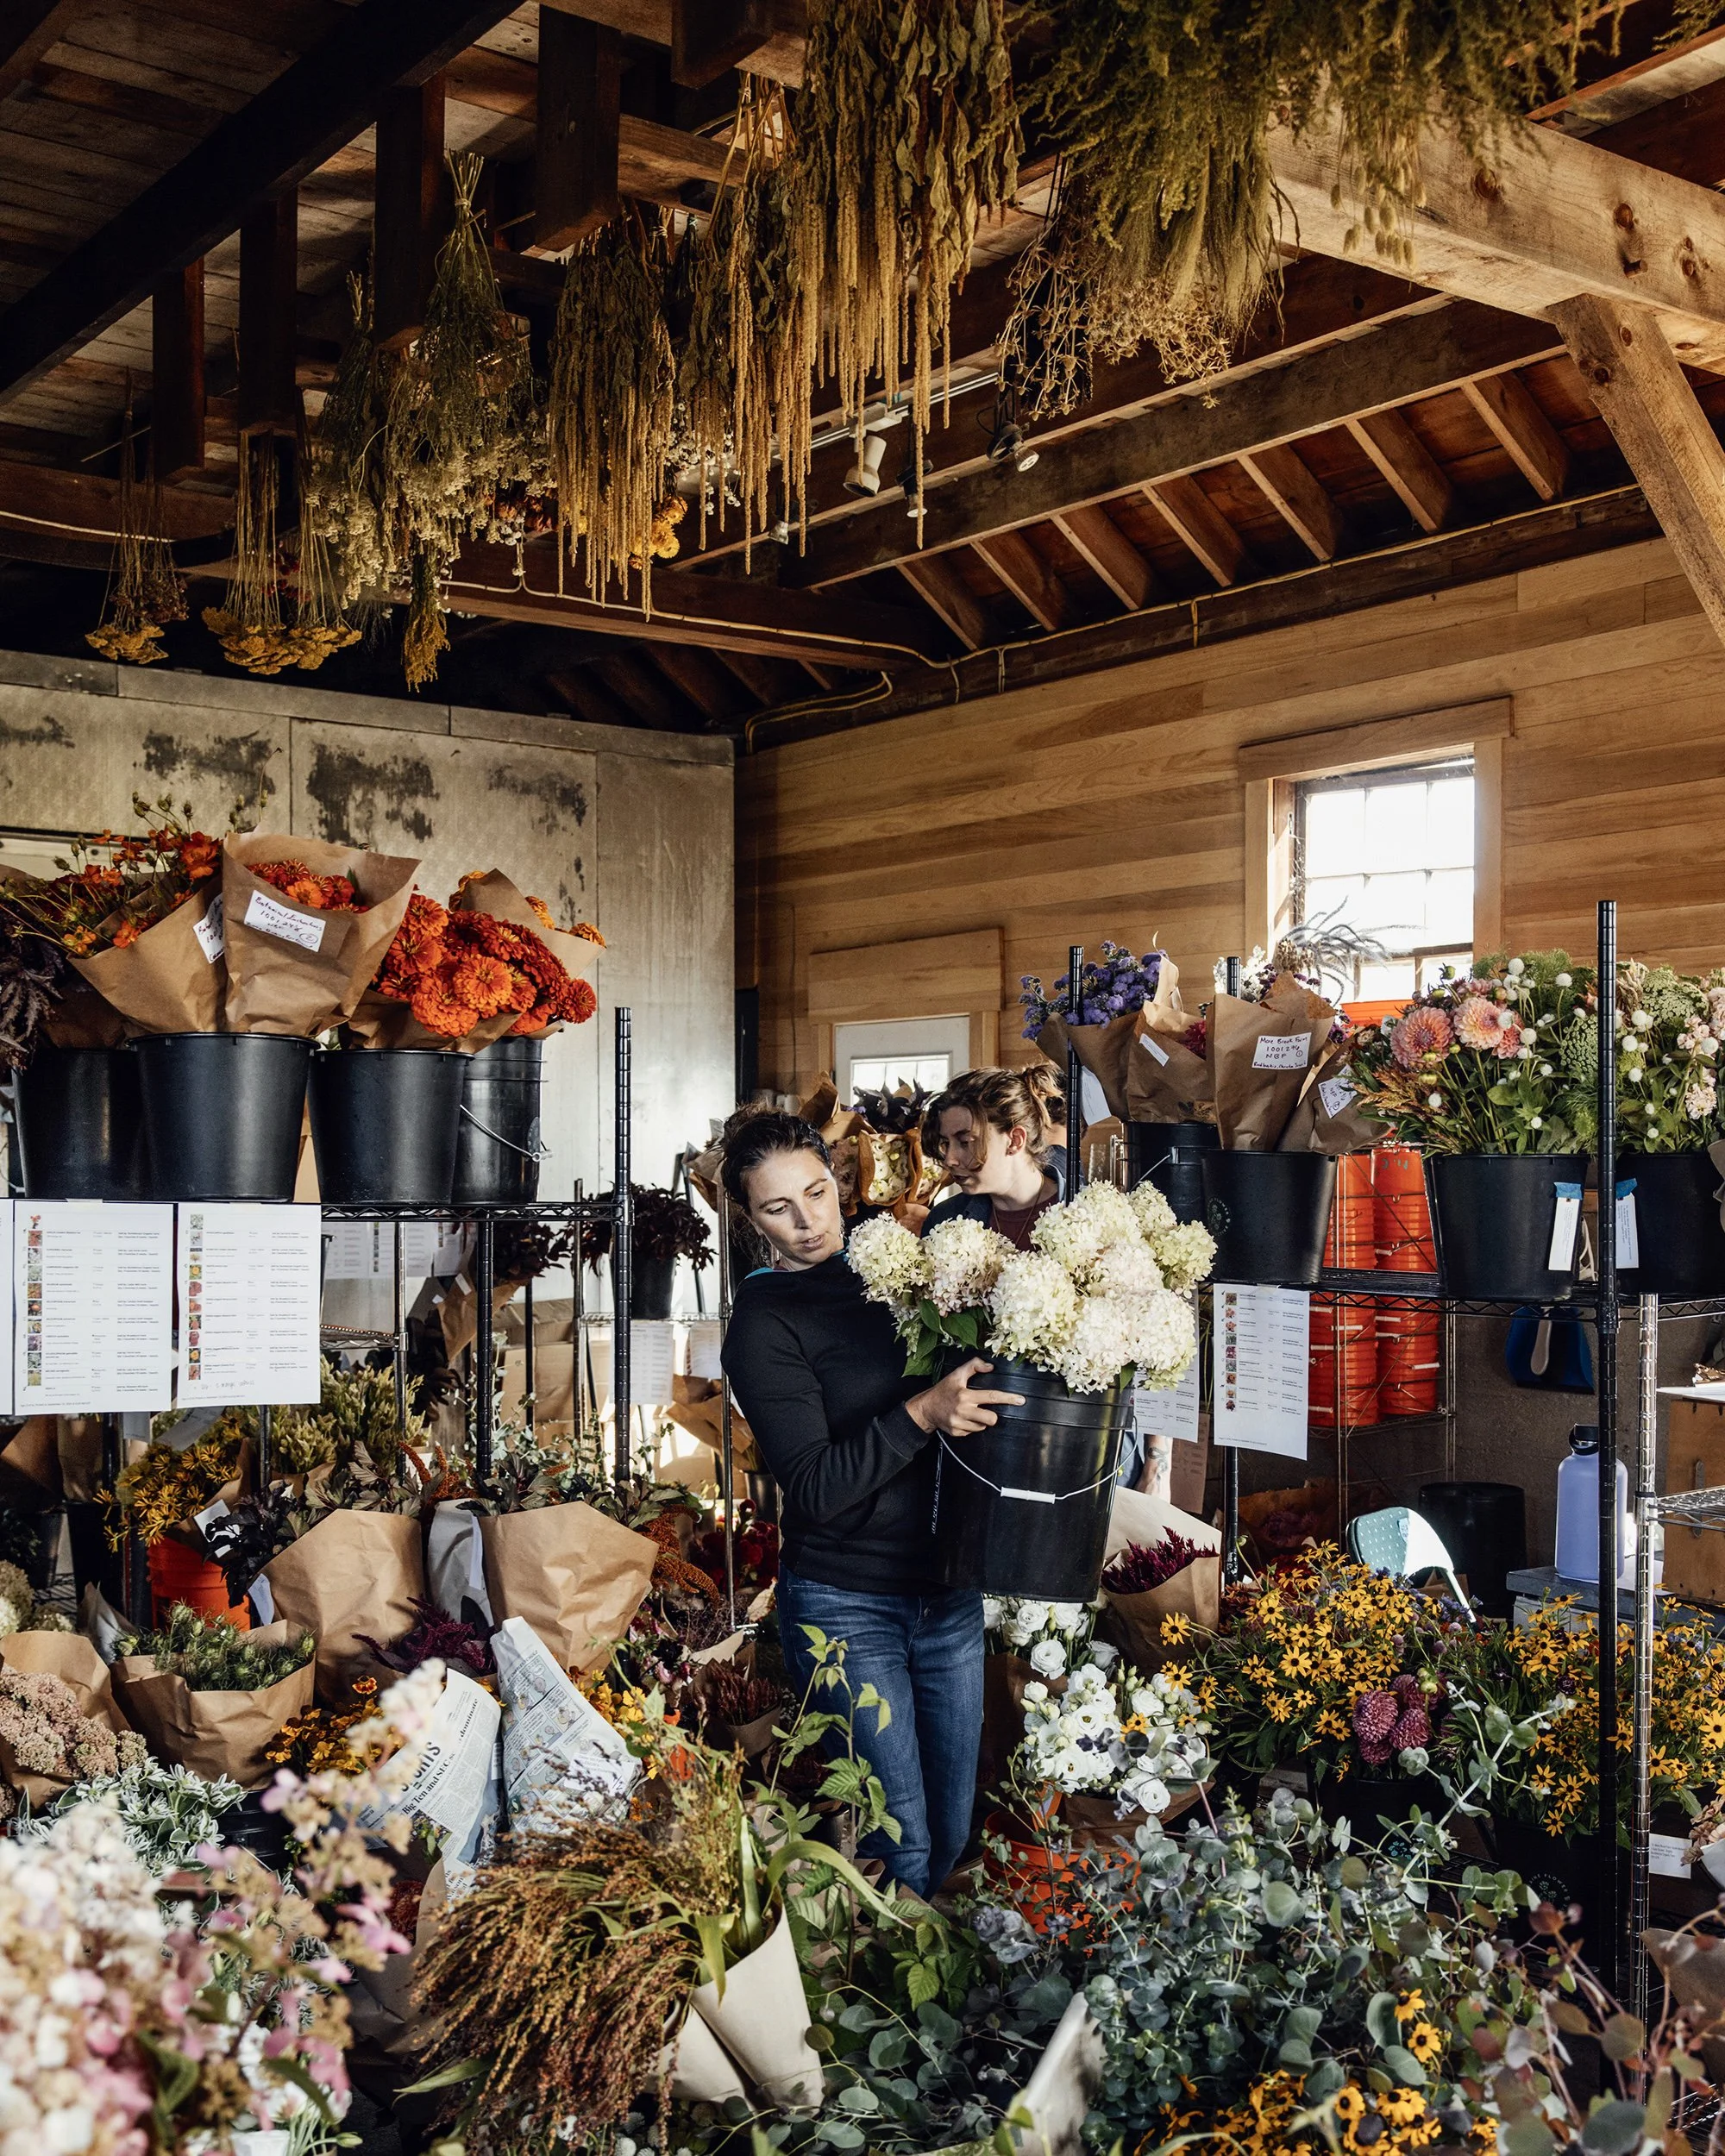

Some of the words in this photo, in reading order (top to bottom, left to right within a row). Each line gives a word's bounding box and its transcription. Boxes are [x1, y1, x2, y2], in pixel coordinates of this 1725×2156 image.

[401, 1802, 417, 1815] Big
[411, 1789, 428, 1804] Ten
[426, 1777, 440, 1792] and
